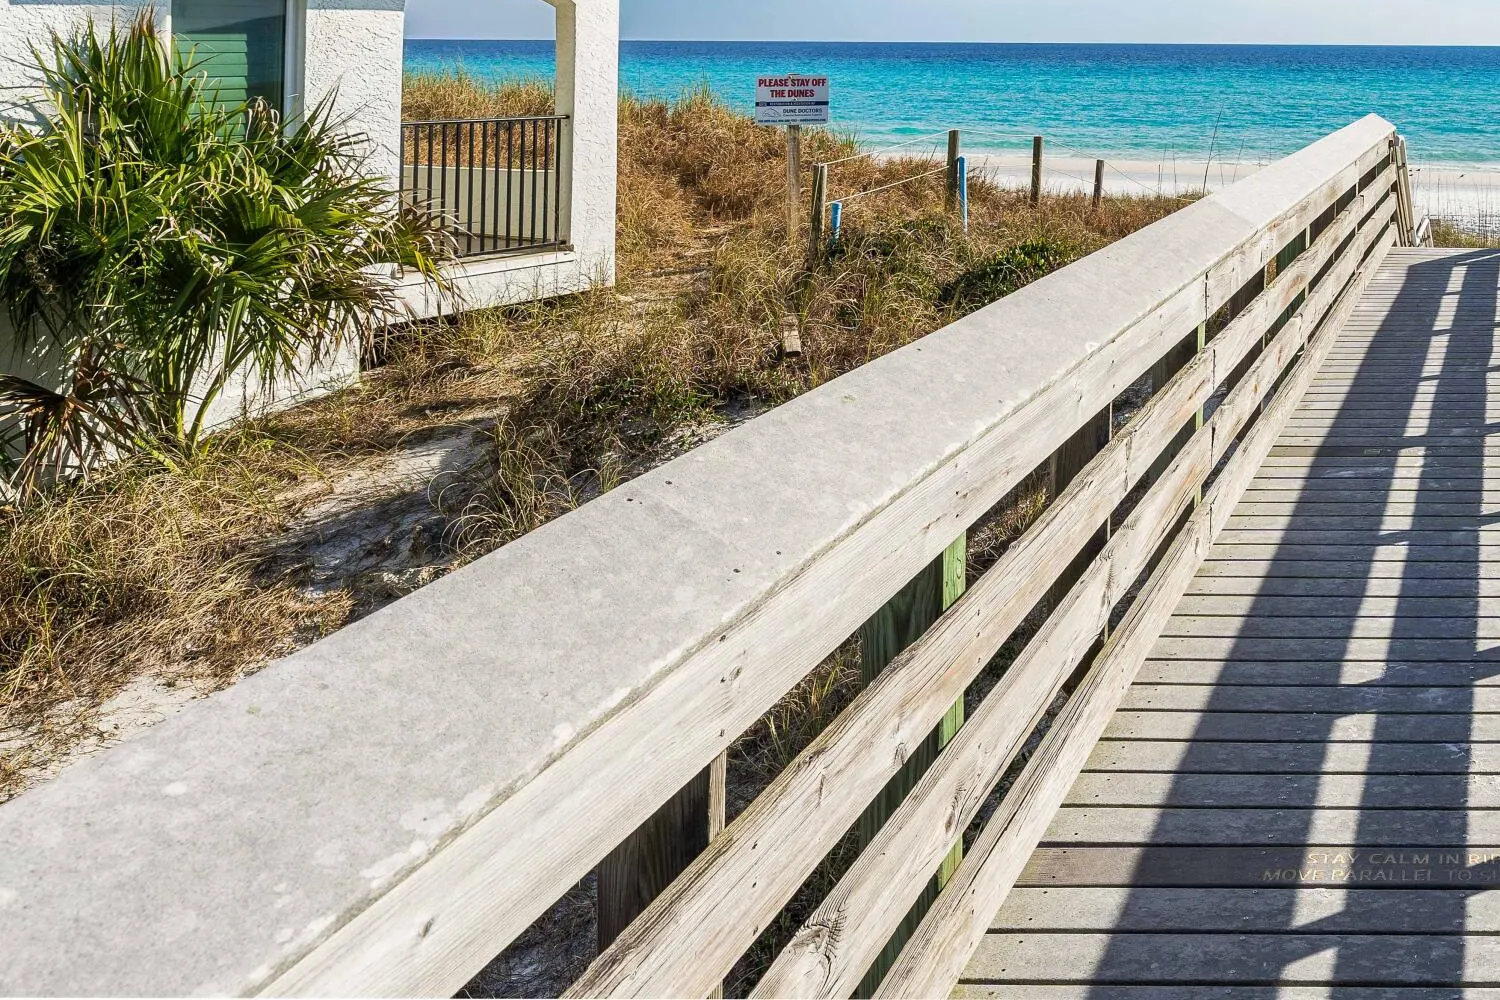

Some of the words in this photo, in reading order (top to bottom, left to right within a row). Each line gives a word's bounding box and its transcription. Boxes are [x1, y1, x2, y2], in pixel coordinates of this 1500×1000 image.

[758, 78, 789, 87] PLEASE
[790, 78, 810, 87] STAY
[811, 78, 827, 86] OFF
[770, 89, 786, 98] THE
[788, 89, 815, 98] DUNES
[1307, 853, 1360, 864] STAY
[1369, 853, 1430, 864] CALM
[1440, 853, 1460, 864] IN
[1262, 869, 1325, 881] MOVE
[1331, 868, 1433, 881] PARALLEL
[1448, 868, 1473, 881] TO
